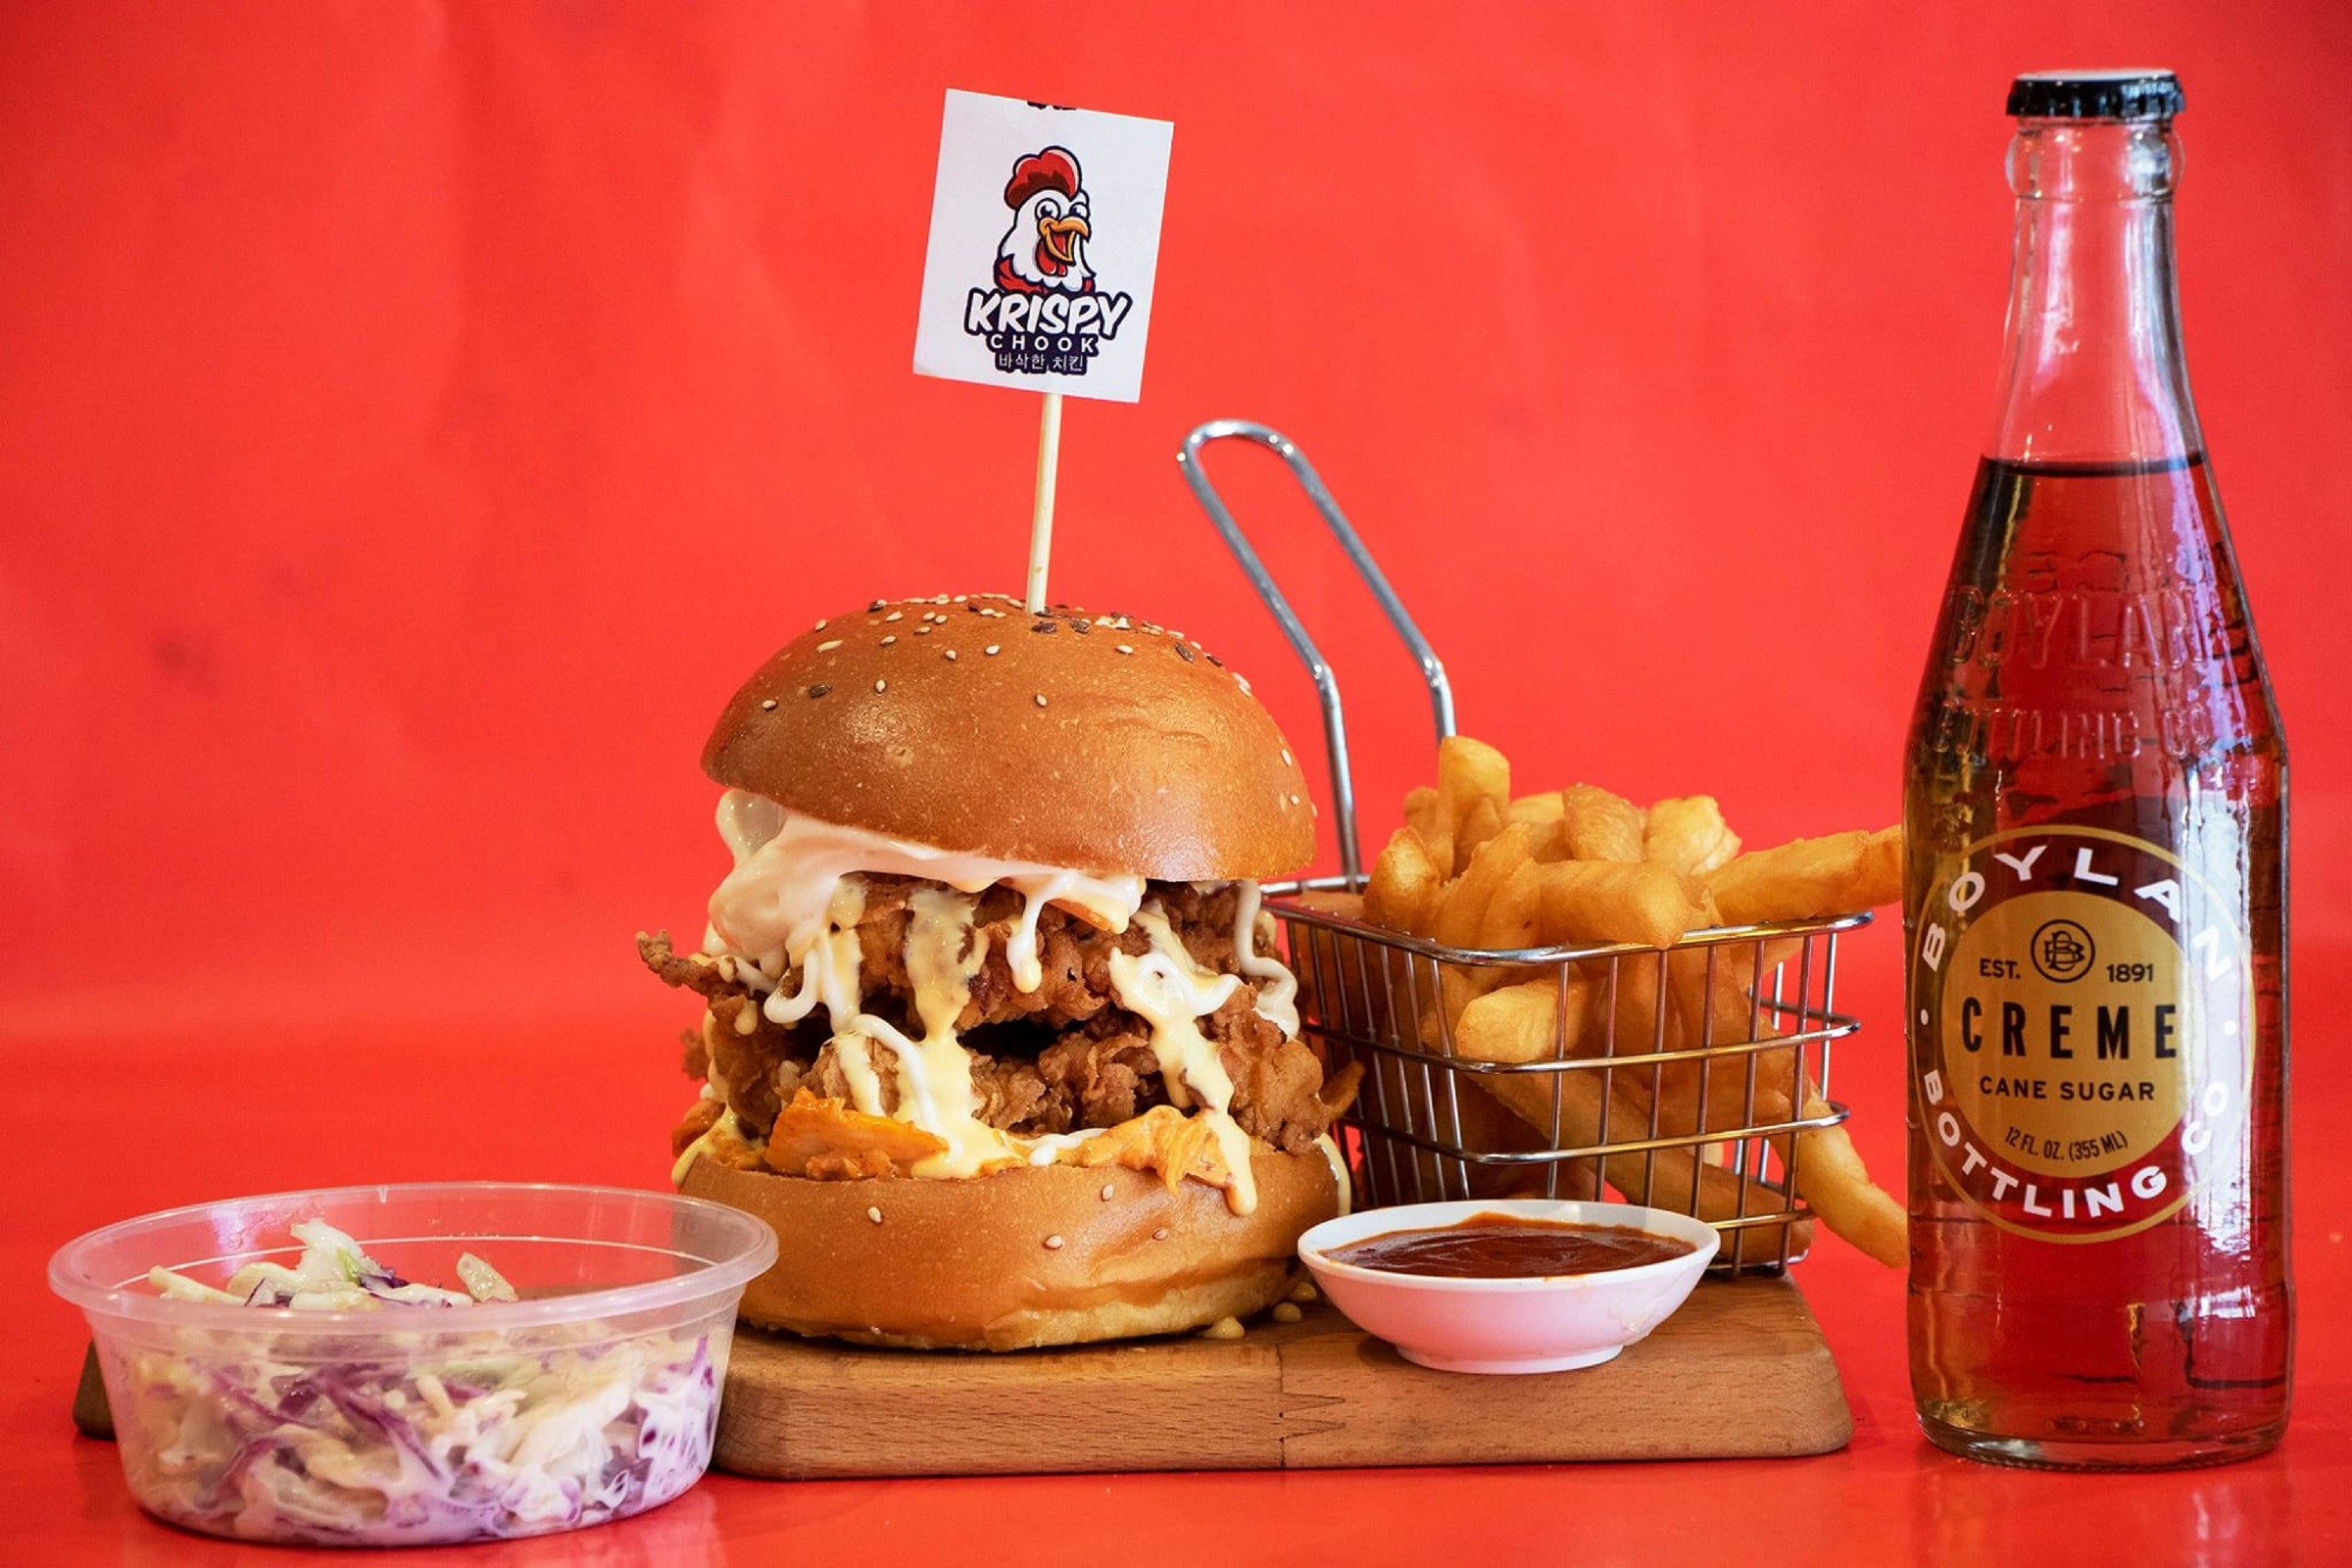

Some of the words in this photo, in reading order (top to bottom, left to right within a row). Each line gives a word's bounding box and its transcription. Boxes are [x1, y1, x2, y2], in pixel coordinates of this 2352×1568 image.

[967, 292, 1128, 337] KRISPY
[990, 334, 1094, 353] CHOOK
[999, 354, 1046, 370] 바삭한
[1052, 354, 1083, 372] 치킨
[1922, 845, 2235, 982] BOYLAN
[1980, 958, 2021, 980] EST.
[2107, 964, 2154, 982] 1891
[1962, 996, 2177, 1060] CREME
[1980, 1076, 2047, 1099] CANE
[2060, 1080, 2155, 1101] SUGAR
[1923, 1069, 2168, 1219] BOTTLING
[2005, 1126, 2021, 1148] 12
[2020, 1133, 2039, 1156] FL.
[2043, 1139, 2065, 1161] OZ.
[2068, 1138, 2100, 1163] (355
[2100, 1130, 2129, 1155] ML)
